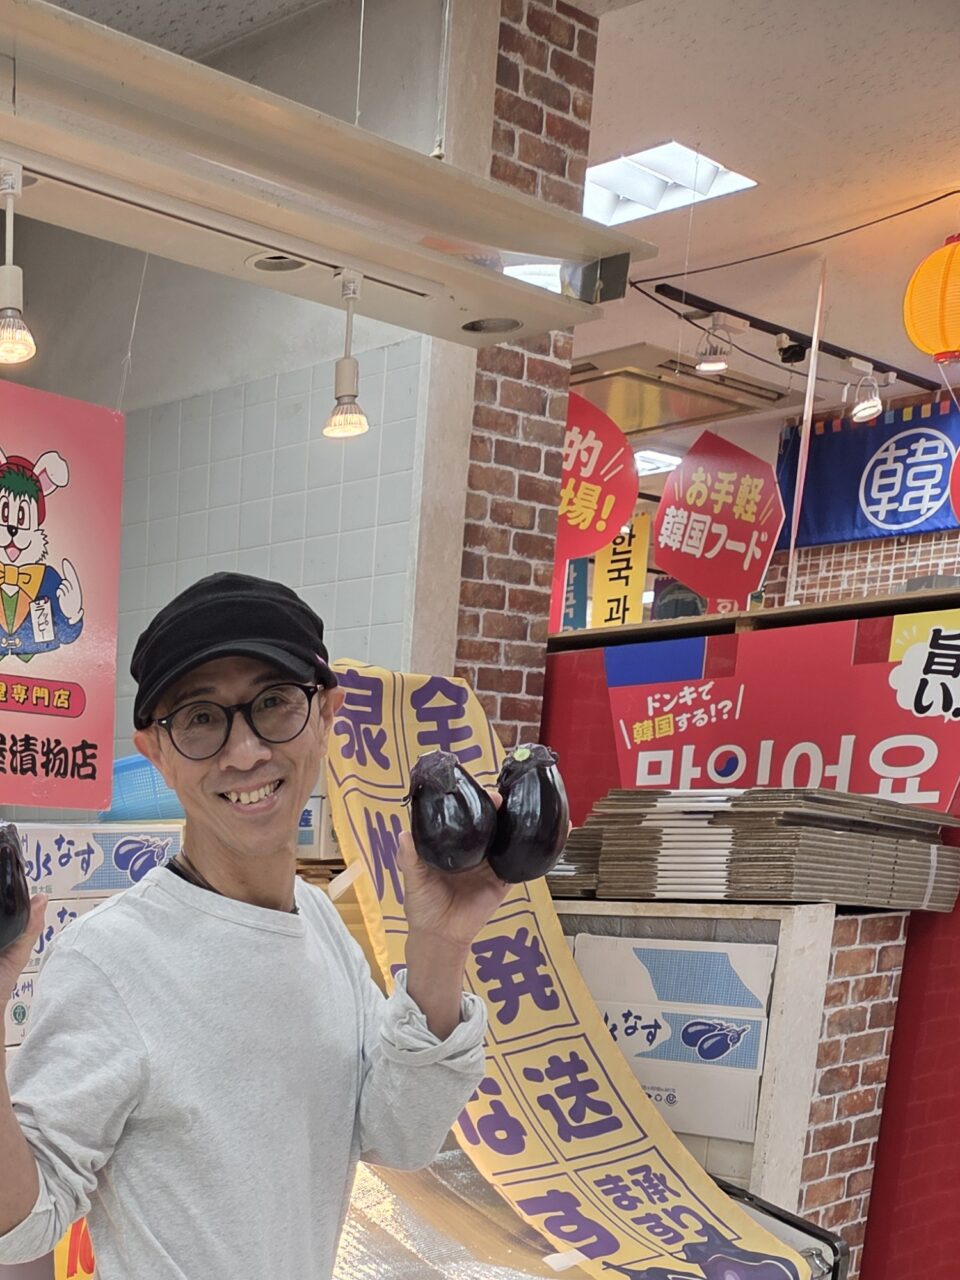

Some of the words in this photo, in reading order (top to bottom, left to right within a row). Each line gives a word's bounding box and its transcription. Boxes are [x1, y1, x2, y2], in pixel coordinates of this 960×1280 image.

[685, 466, 766, 524] お手軽
[867, 438, 948, 520] 韓
[657, 504, 769, 572] 韓国フード
[632, 699, 734, 744] 韓国する!?
[647, 681, 715, 716] ドンキで
[25, 834, 95, 882] 水なす
